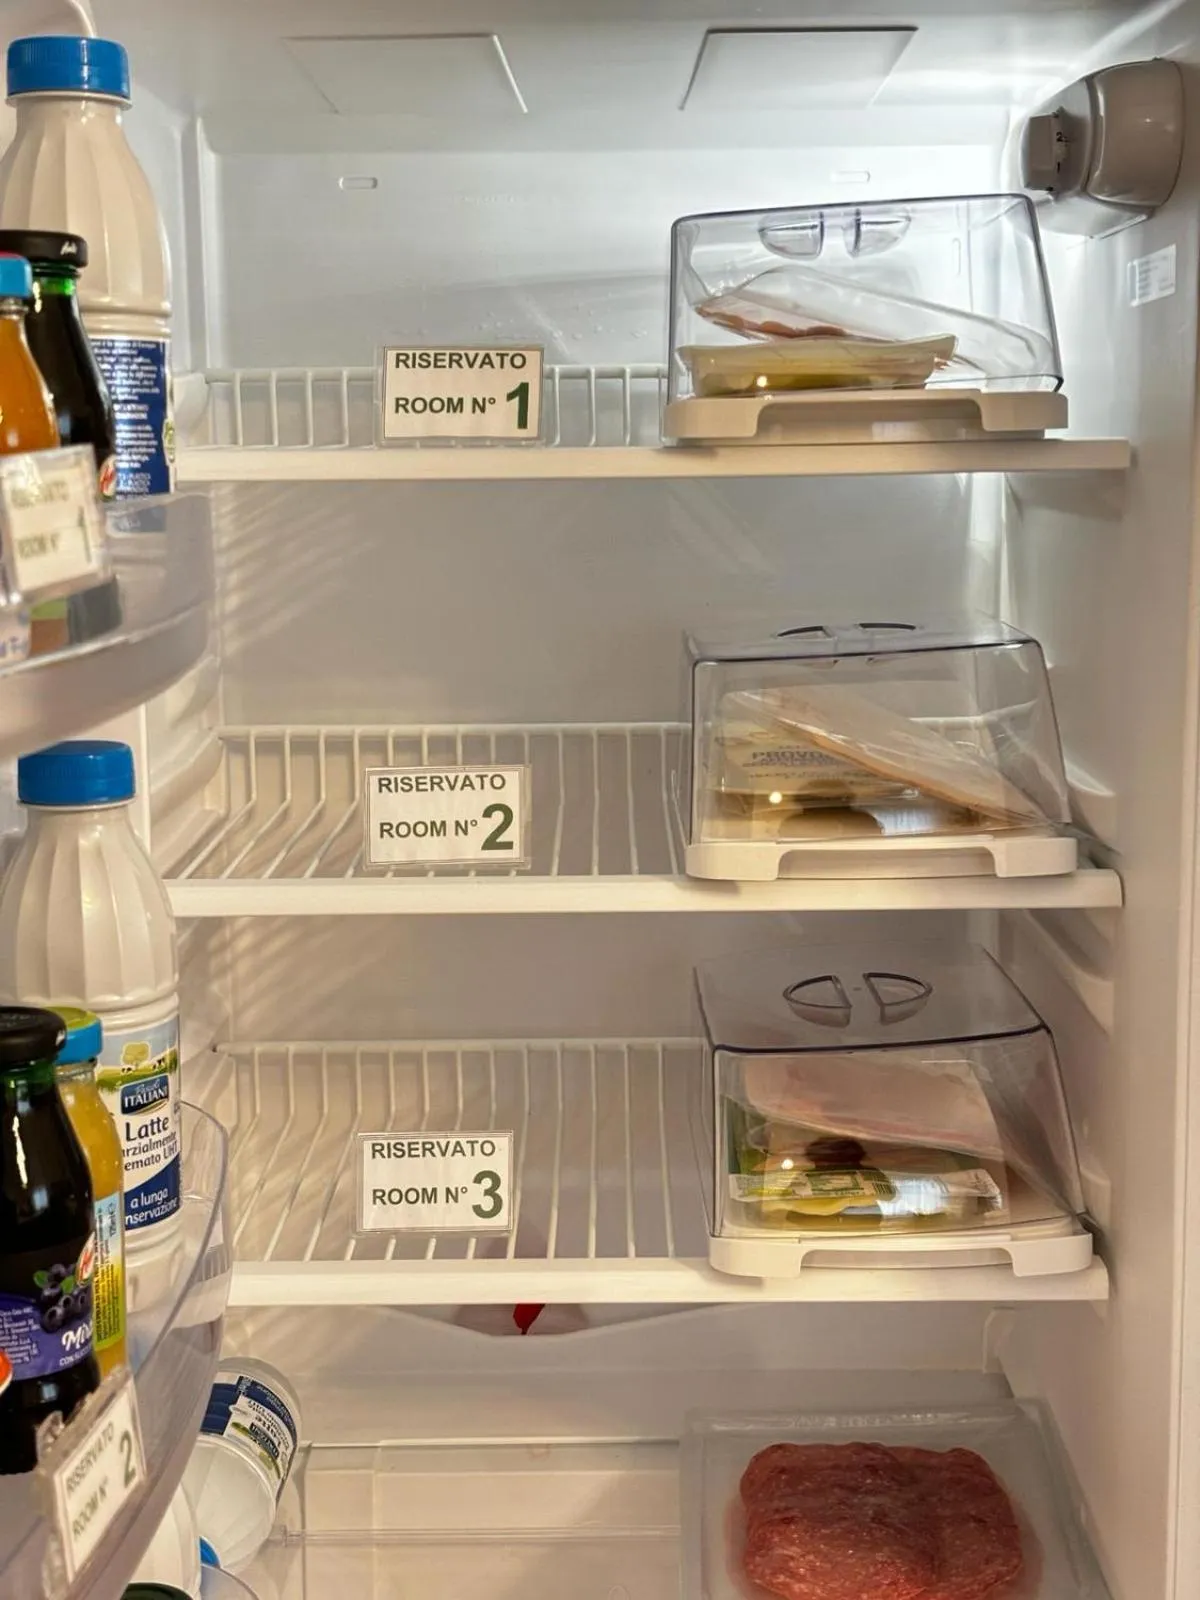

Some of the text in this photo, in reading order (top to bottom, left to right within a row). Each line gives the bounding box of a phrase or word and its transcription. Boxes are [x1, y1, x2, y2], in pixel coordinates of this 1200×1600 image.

[395, 352, 527, 369] RISERVATO
[394, 382, 530, 430] ROOM N° 1
[378, 774, 506, 793] RISERVATO
[379, 803, 514, 851] ROOM N° 2
[125, 1116, 169, 1141] Latte
[371, 1140, 496, 1159] RISERVATO
[124, 1154, 161, 1171] emato
[130, 1188, 168, 1209] a lunga
[372, 1170, 503, 1219] ROOM N° 3
[125, 1197, 178, 1225] nservazione
[119, 1430, 138, 1488] 2
